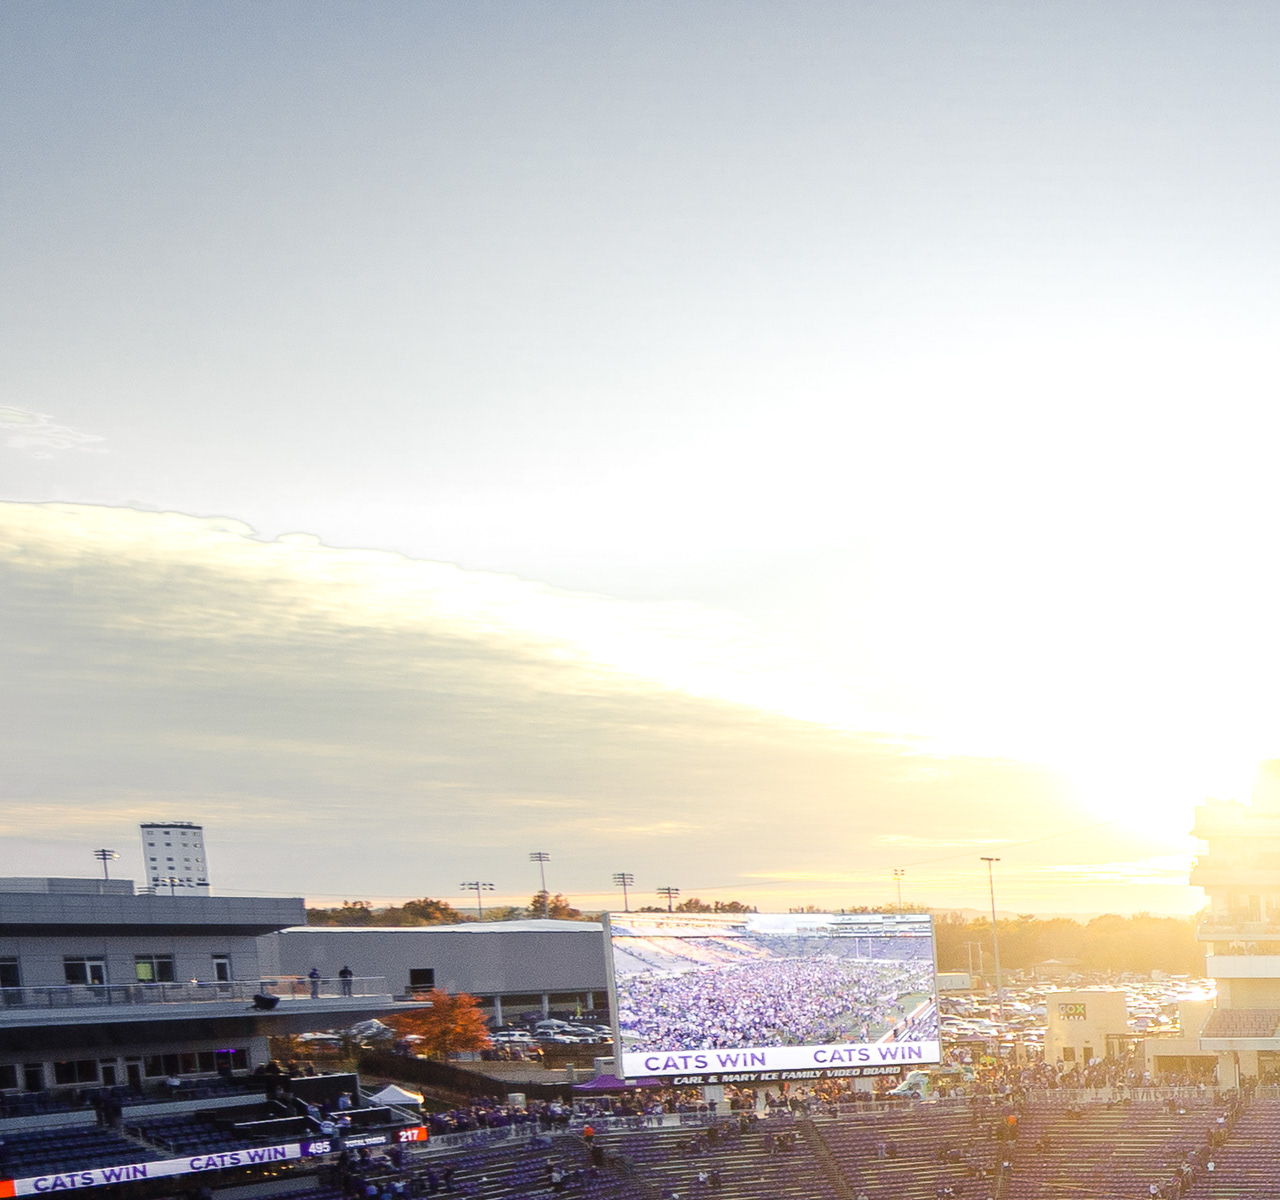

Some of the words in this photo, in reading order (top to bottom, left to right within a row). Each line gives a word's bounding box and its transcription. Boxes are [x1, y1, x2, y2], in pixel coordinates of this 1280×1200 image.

[1059, 1004, 1085, 1014] COX
[644, 1054, 708, 1072] CATS
[716, 1052, 766, 1068] WIN
[813, 1048, 870, 1064] CATS
[877, 1045, 923, 1062] WIN
[674, 1075, 705, 1085] CARL
[708, 1075, 718, 1083] &
[721, 1074, 758, 1083] MARY
[760, 1072, 779, 1080] ICE
[781, 1070, 823, 1080] FAMILY
[826, 1068, 860, 1077] VIDEO
[863, 1067, 901, 1076] BOARD
[399, 1130, 419, 1142] 217
[309, 1141, 331, 1154] 495
[190, 1153, 241, 1170] CATS
[246, 1147, 287, 1163] WIN
[34, 1172, 94, 1192] CATS
[101, 1165, 148, 1182] WIN
